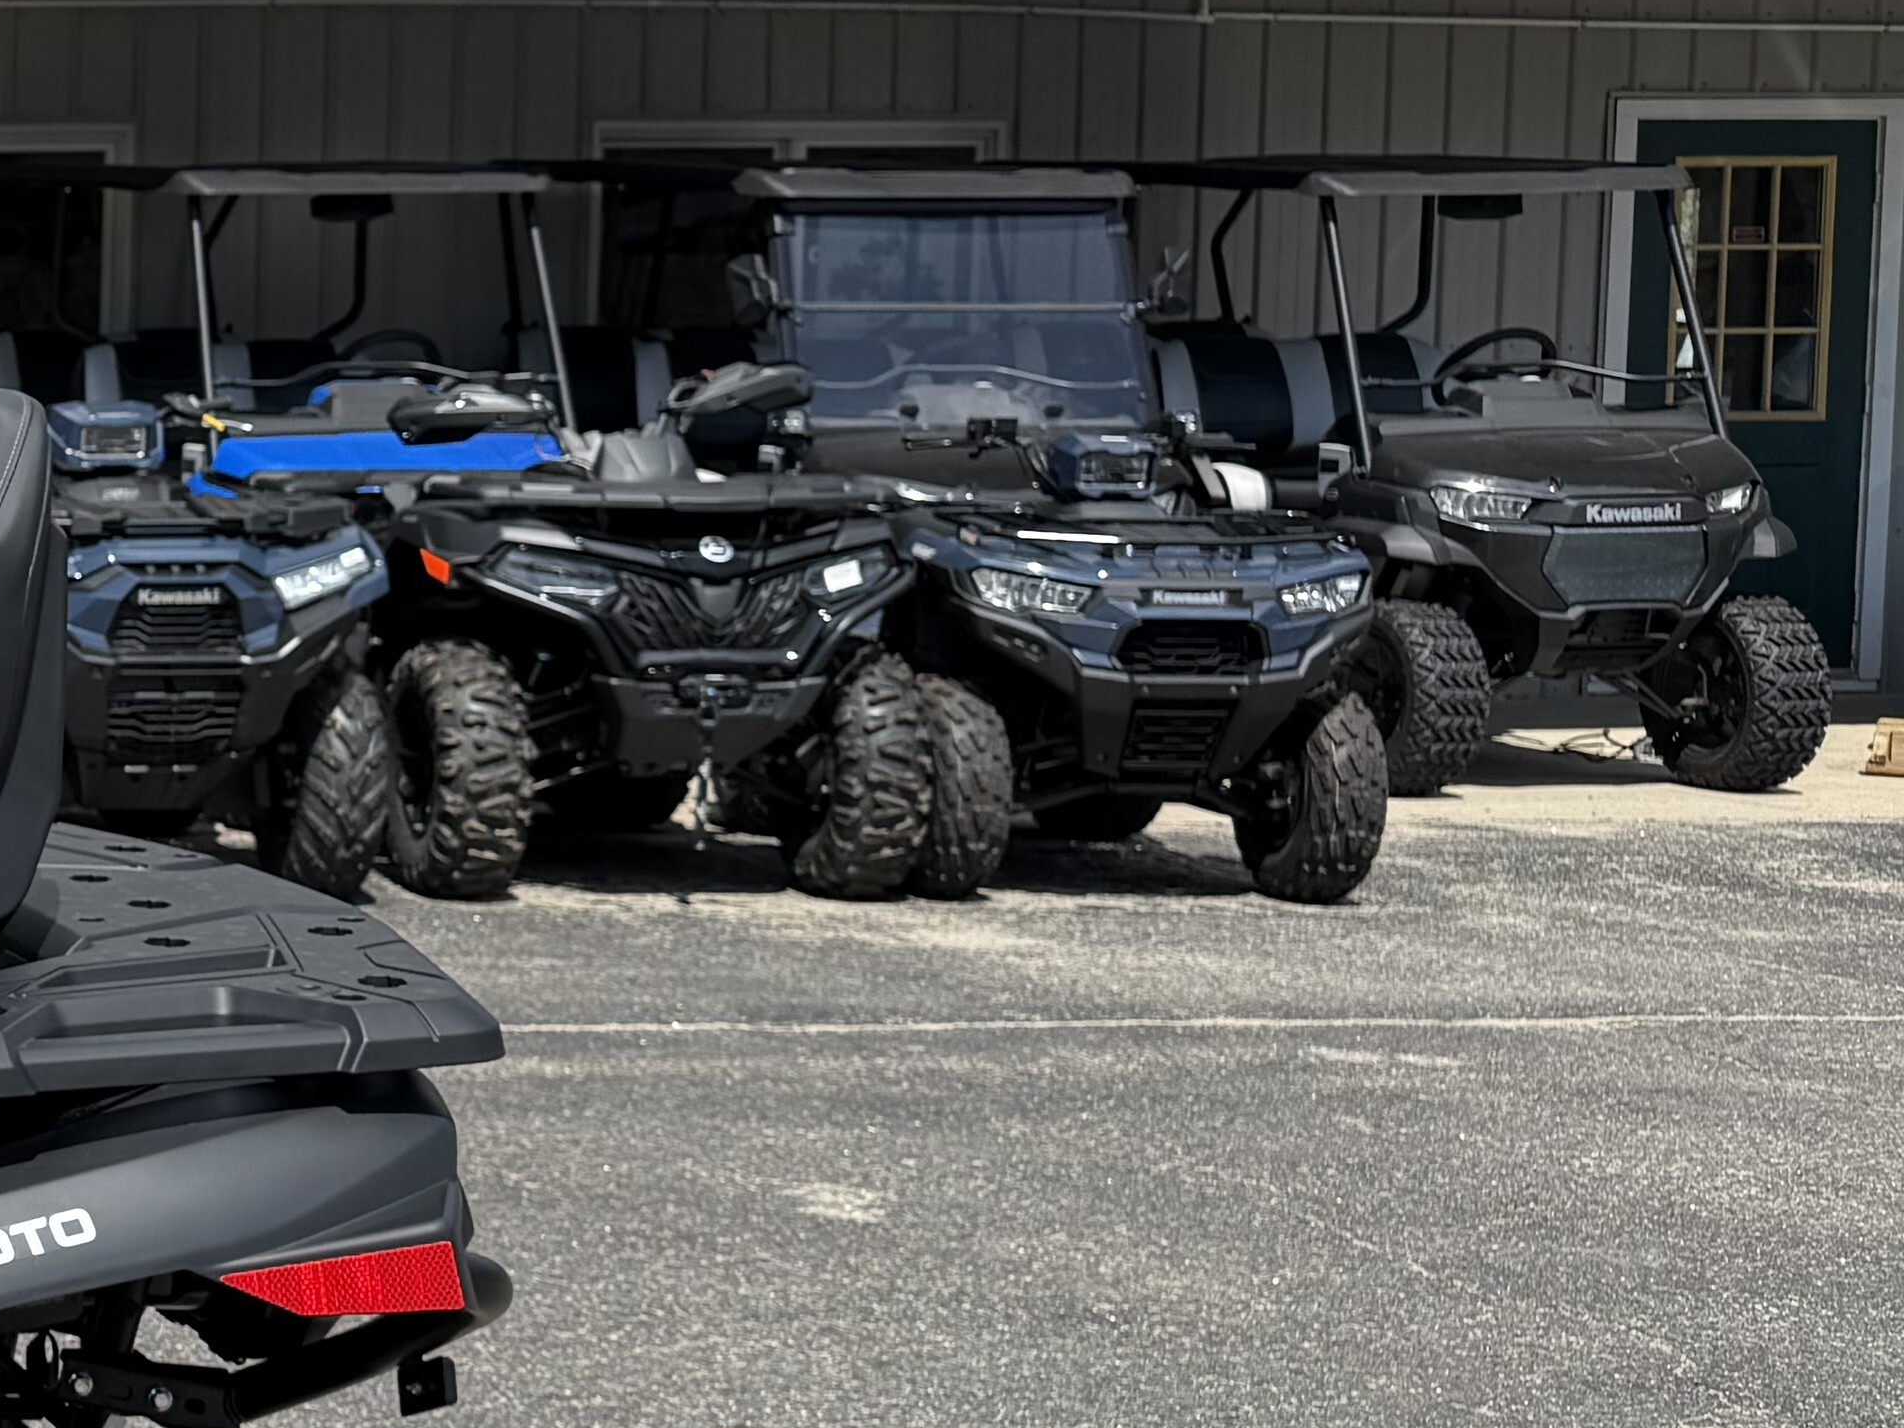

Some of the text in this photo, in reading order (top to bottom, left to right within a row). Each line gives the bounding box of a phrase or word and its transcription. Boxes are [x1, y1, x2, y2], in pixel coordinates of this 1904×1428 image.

[1585, 502, 1682, 523] Kawasaki
[137, 587, 221, 606] Kawasaki
[1152, 589, 1226, 606] Kawasaki
